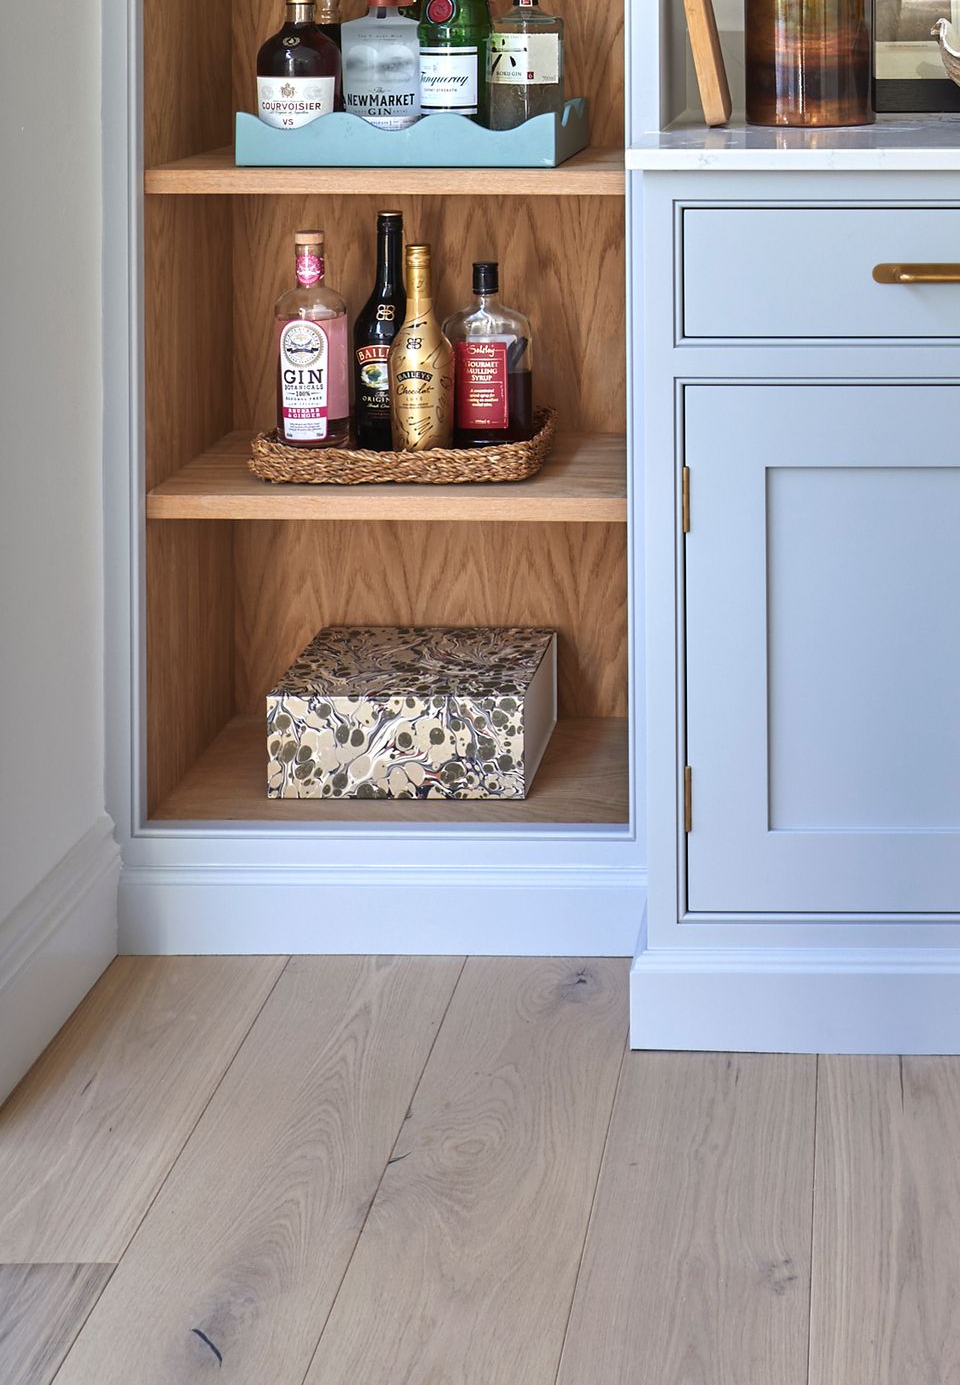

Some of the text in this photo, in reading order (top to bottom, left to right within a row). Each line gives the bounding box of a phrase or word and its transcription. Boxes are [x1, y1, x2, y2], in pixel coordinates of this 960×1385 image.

[347, 93, 415, 107] NEWMARKET
[262, 102, 321, 111] COURVOISIER
[368, 108, 392, 116] GIN
[282, 118, 294, 126] VS
[284, 369, 324, 384] GIN
[398, 371, 431, 382] BAILEYS
[396, 382, 434, 396] Chocolat
